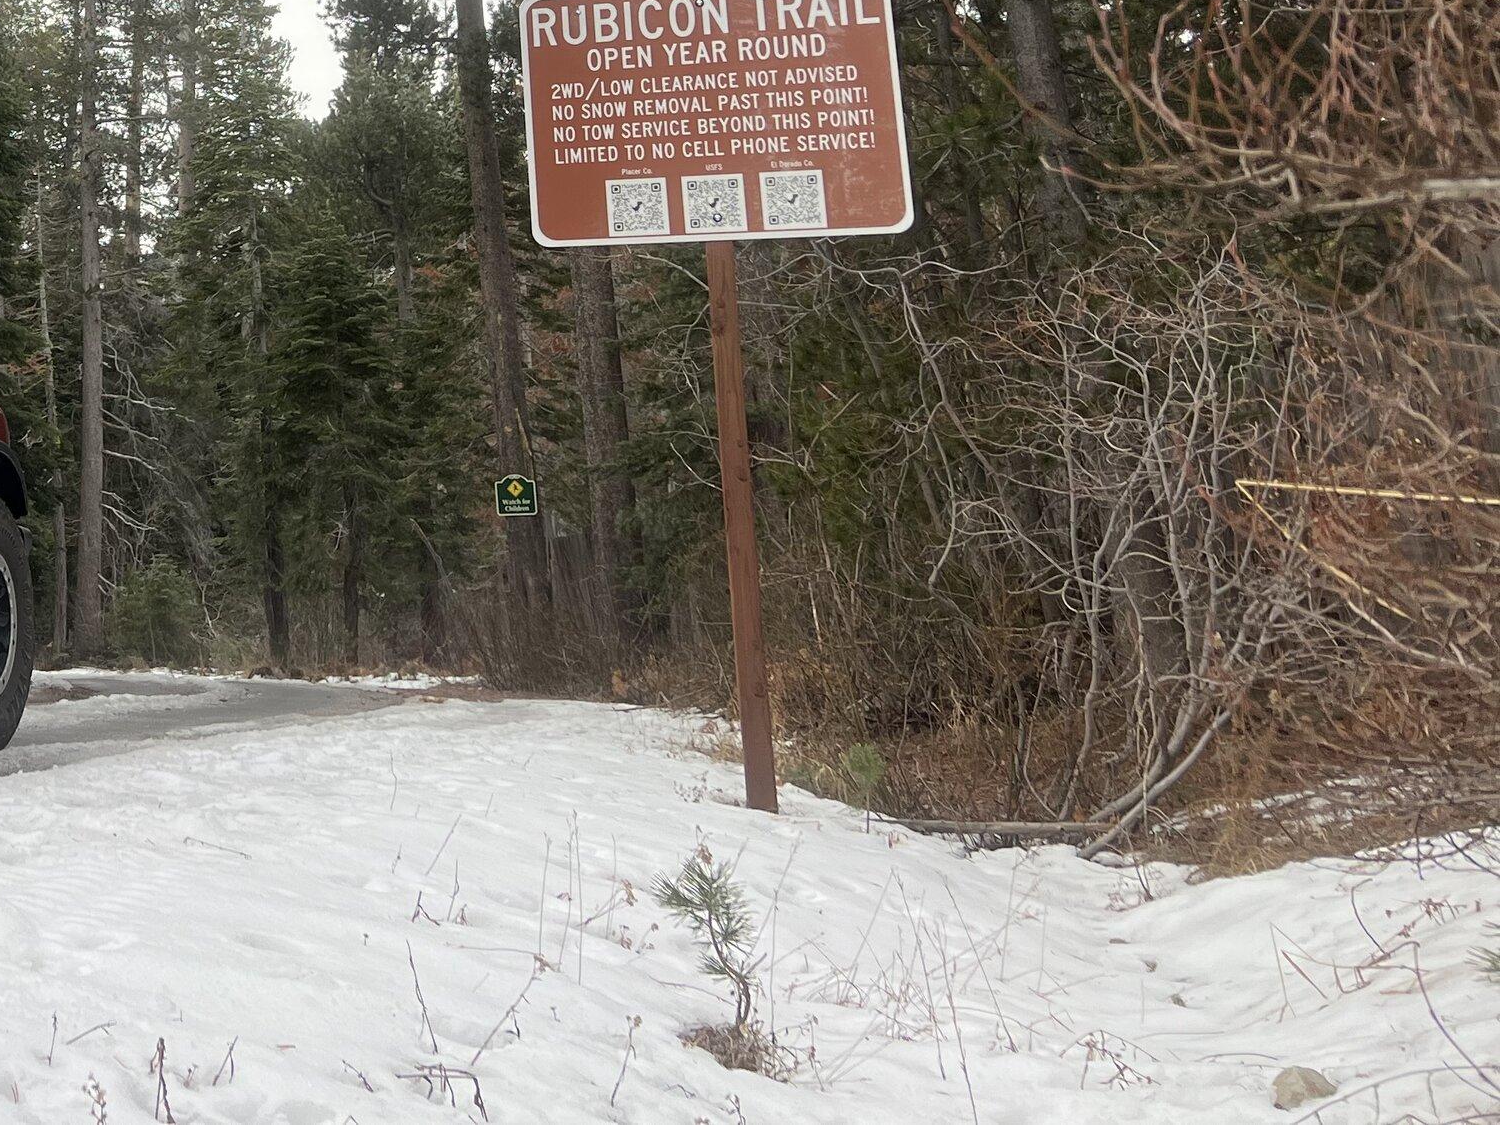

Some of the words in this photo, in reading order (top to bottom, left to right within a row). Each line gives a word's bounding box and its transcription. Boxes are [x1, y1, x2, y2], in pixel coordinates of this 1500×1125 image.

[587, 45, 652, 72] OPEN
[663, 40, 728, 66] YEAR
[737, 33, 826, 62] ROUND
[551, 78, 633, 100] 2WD/LOW
[641, 72, 739, 94] CLEARANCE
[745, 70, 778, 87] NOT
[785, 65, 858, 85] ADVISED
[552, 104, 574, 121] NO
[581, 101, 626, 119] SNOW
[634, 96, 712, 116] REMOVAL
[718, 93, 759, 111] PAST
[765, 90, 804, 108] THIS
[810, 86, 868, 105] POINT!
[553, 126, 576, 143] NO
[582, 124, 615, 141] TOW
[621, 119, 691, 139] SERVICE
[697, 115, 766, 135] BEYOND
[772, 112, 811, 130] THIS
[817, 109, 875, 128] POINT!
[554, 145, 618, 165] LIMITED
[624, 144, 645, 161] TO
[652, 142, 675, 159] NO
[682, 140, 724, 158] CELL
[730, 137, 790, 155] PHONE
[797, 132, 876, 152] SERVICE!
[779, 160, 803, 168] Dorado
[803, 159, 814, 167] Co.
[621, 167, 641, 175] Placer
[642, 167, 653, 175] Co.
